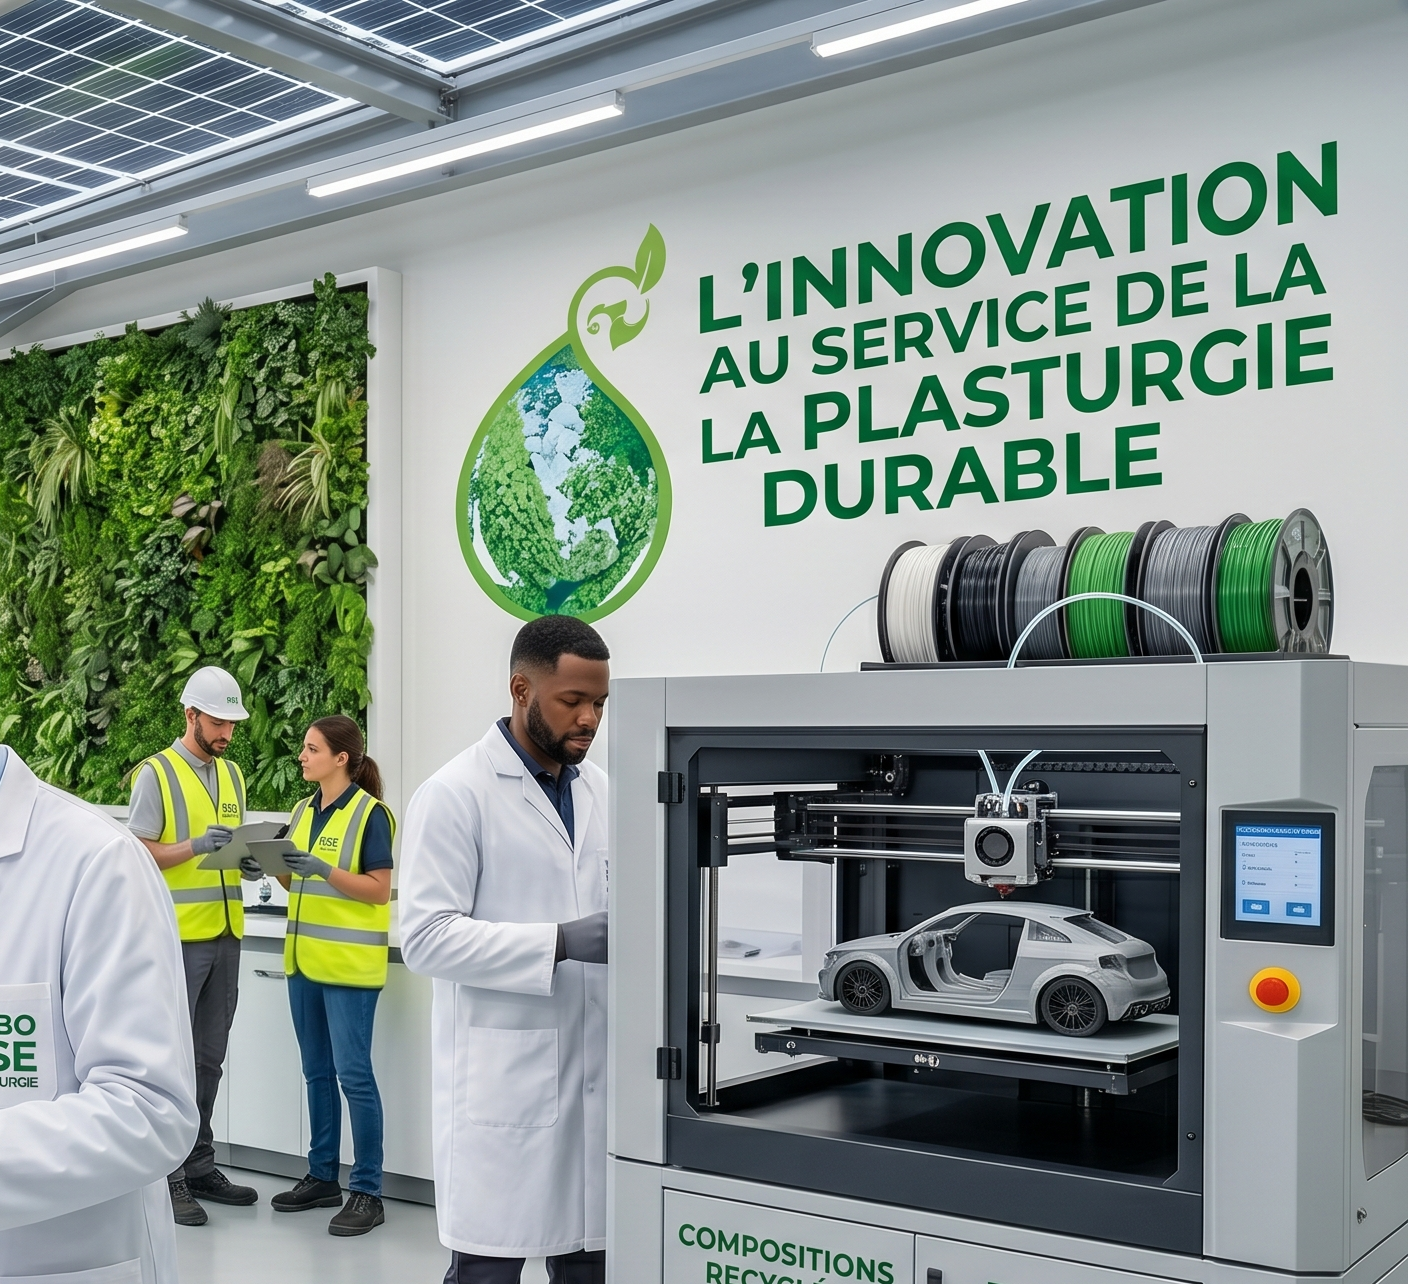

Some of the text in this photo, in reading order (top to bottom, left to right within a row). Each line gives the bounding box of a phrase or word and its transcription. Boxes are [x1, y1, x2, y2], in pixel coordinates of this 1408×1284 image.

[698, 140, 1339, 334] L'INNOVATION
[699, 242, 1327, 394] AU SERVICE DE LA
[701, 313, 1335, 464] LA PLASTURGIE
[763, 422, 1164, 527] DURABLE
[678, 1223, 894, 1284] COMPOSITIONS
